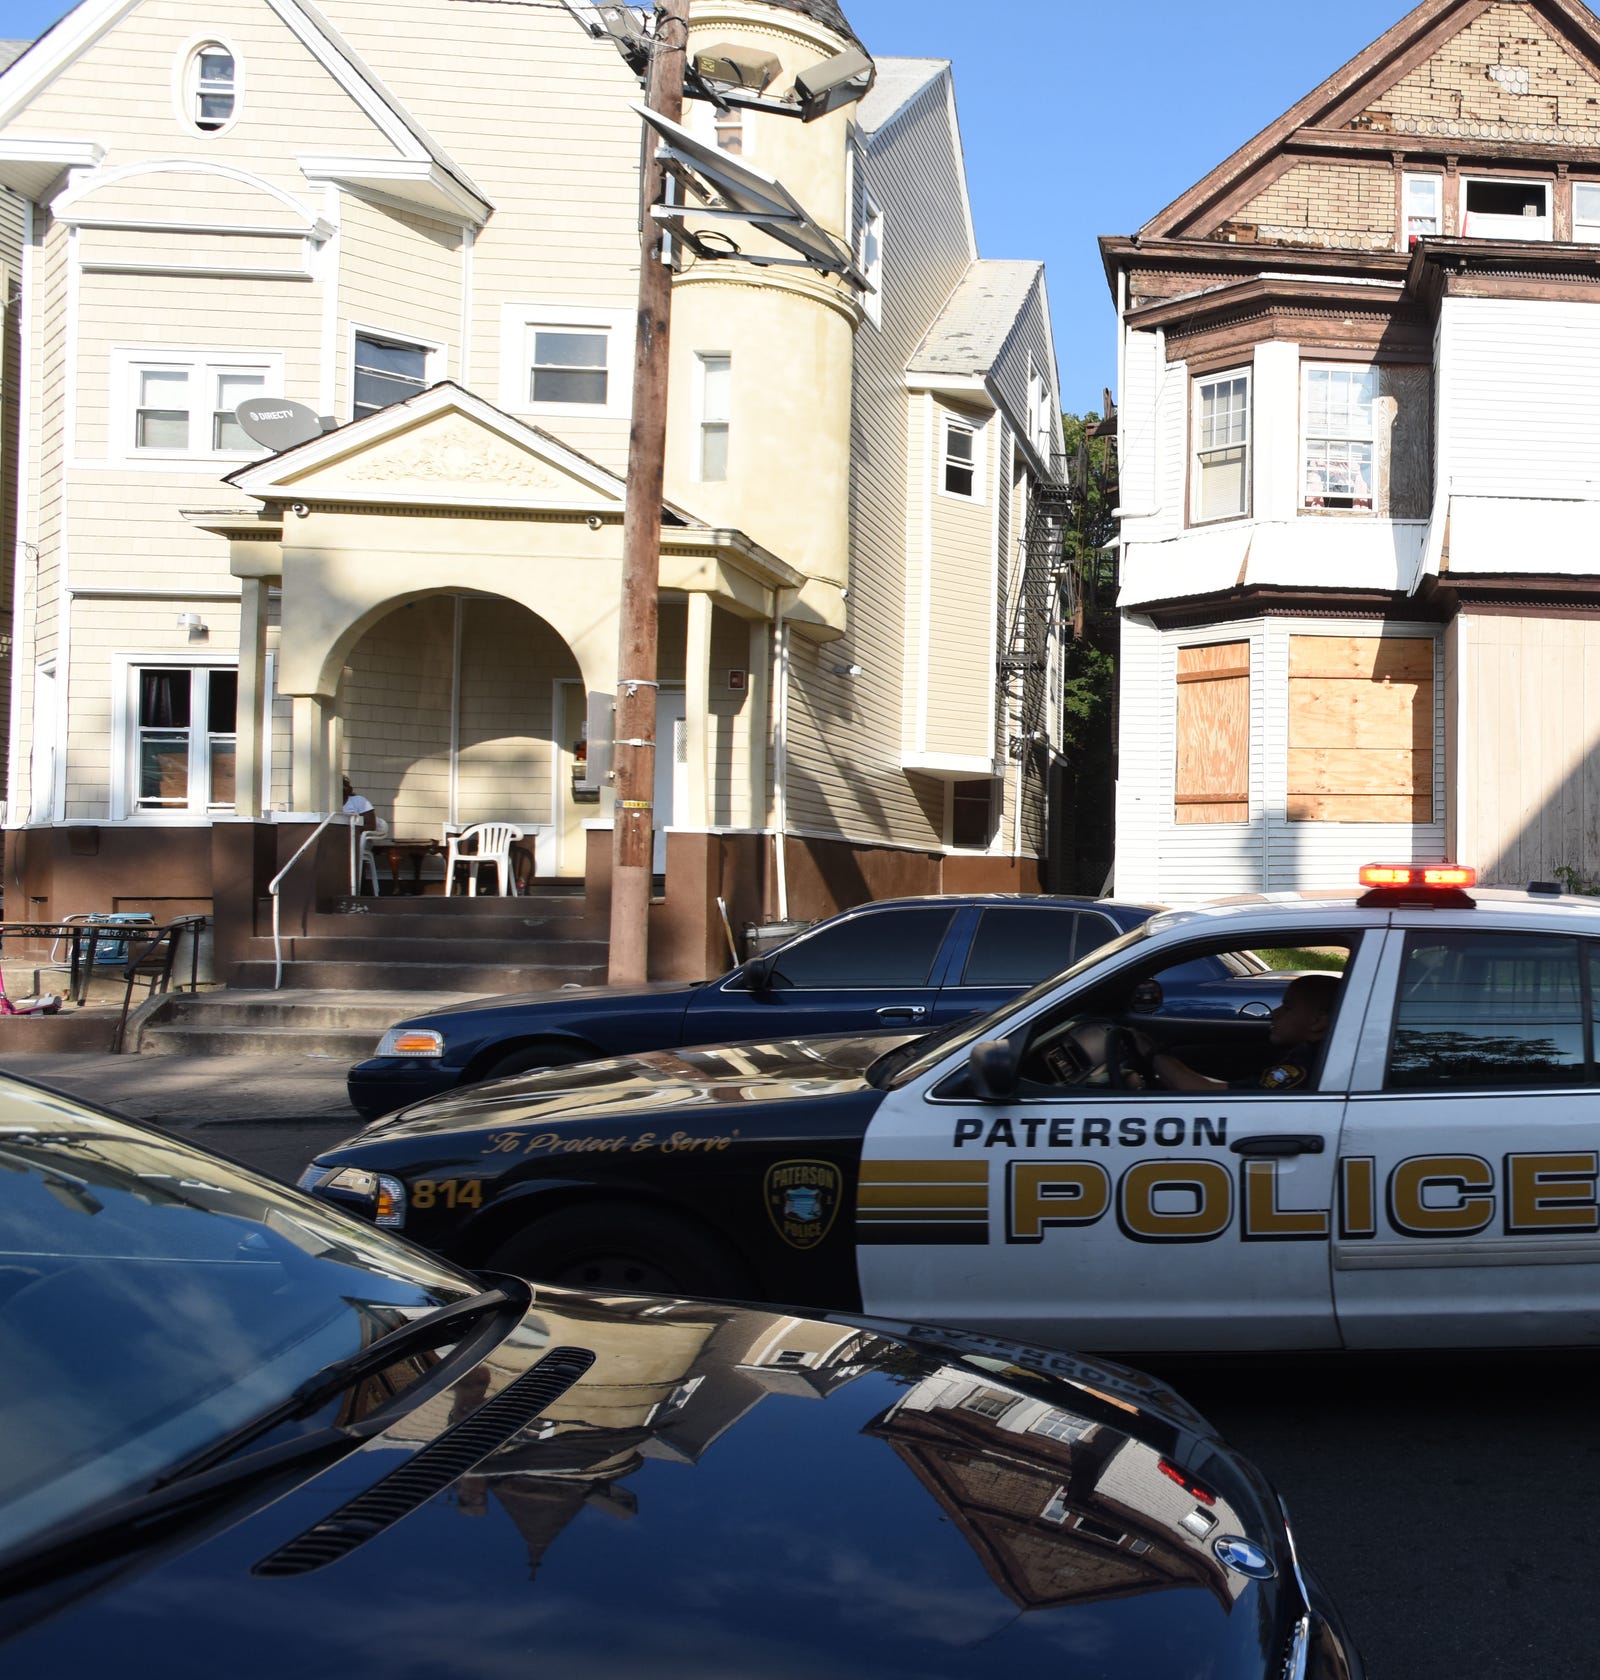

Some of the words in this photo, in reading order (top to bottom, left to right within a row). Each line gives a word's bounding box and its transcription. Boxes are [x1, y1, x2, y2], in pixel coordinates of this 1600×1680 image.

[258, 409, 293, 420] DIRECTV
[523, 1133, 627, 1154] Protect
[630, 1132, 656, 1152] &
[954, 1117, 1227, 1148] PATERSON
[773, 1166, 833, 1189] PATERSON
[411, 1180, 482, 1208] 814
[1005, 1151, 1600, 1244] POLICE
[784, 1221, 822, 1237] POLICE
